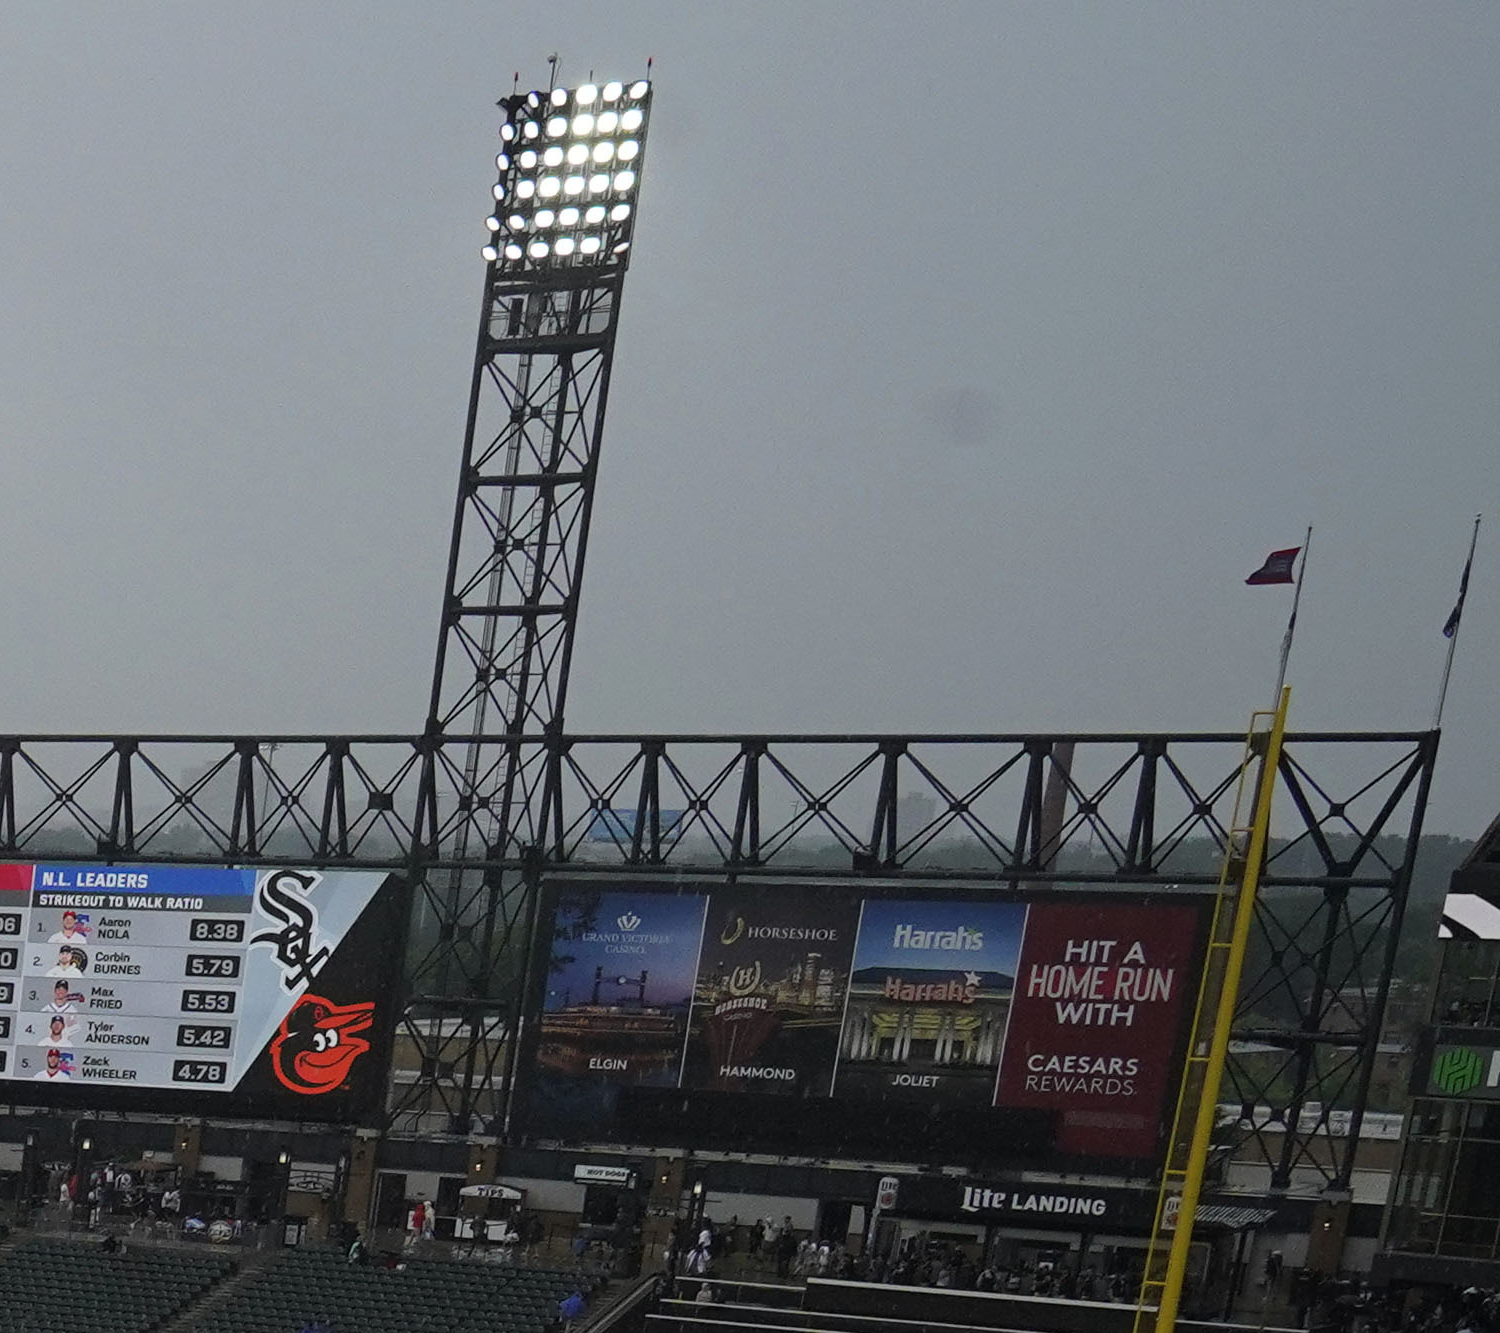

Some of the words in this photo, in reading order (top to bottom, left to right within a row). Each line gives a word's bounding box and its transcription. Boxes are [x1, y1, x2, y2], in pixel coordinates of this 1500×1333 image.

[42, 872, 70, 888] N.L.
[75, 873, 149, 890] LEADERS
[98, 928, 130, 940] NOLA
[196, 923, 239, 940] 8.38
[747, 926, 838, 941] HORSESHOE
[1063, 940, 1116, 964] HIT
[1120, 940, 1147, 965] A
[93, 962, 142, 976] BURNES
[191, 957, 234, 975] 5.79
[1026, 963, 1104, 999] HOME
[1112, 967, 1175, 1003] RUN
[1054, 1001, 1135, 1028] WITH
[588, 1057, 628, 1072] ELGIN
[719, 1064, 796, 1082] HAMMOND
[1026, 1053, 1141, 1077] CAESARS
[892, 1074, 940, 1089] JOLIET
[961, 1186, 1007, 1214] Lite
[1010, 1192, 1108, 1218] LANDING
